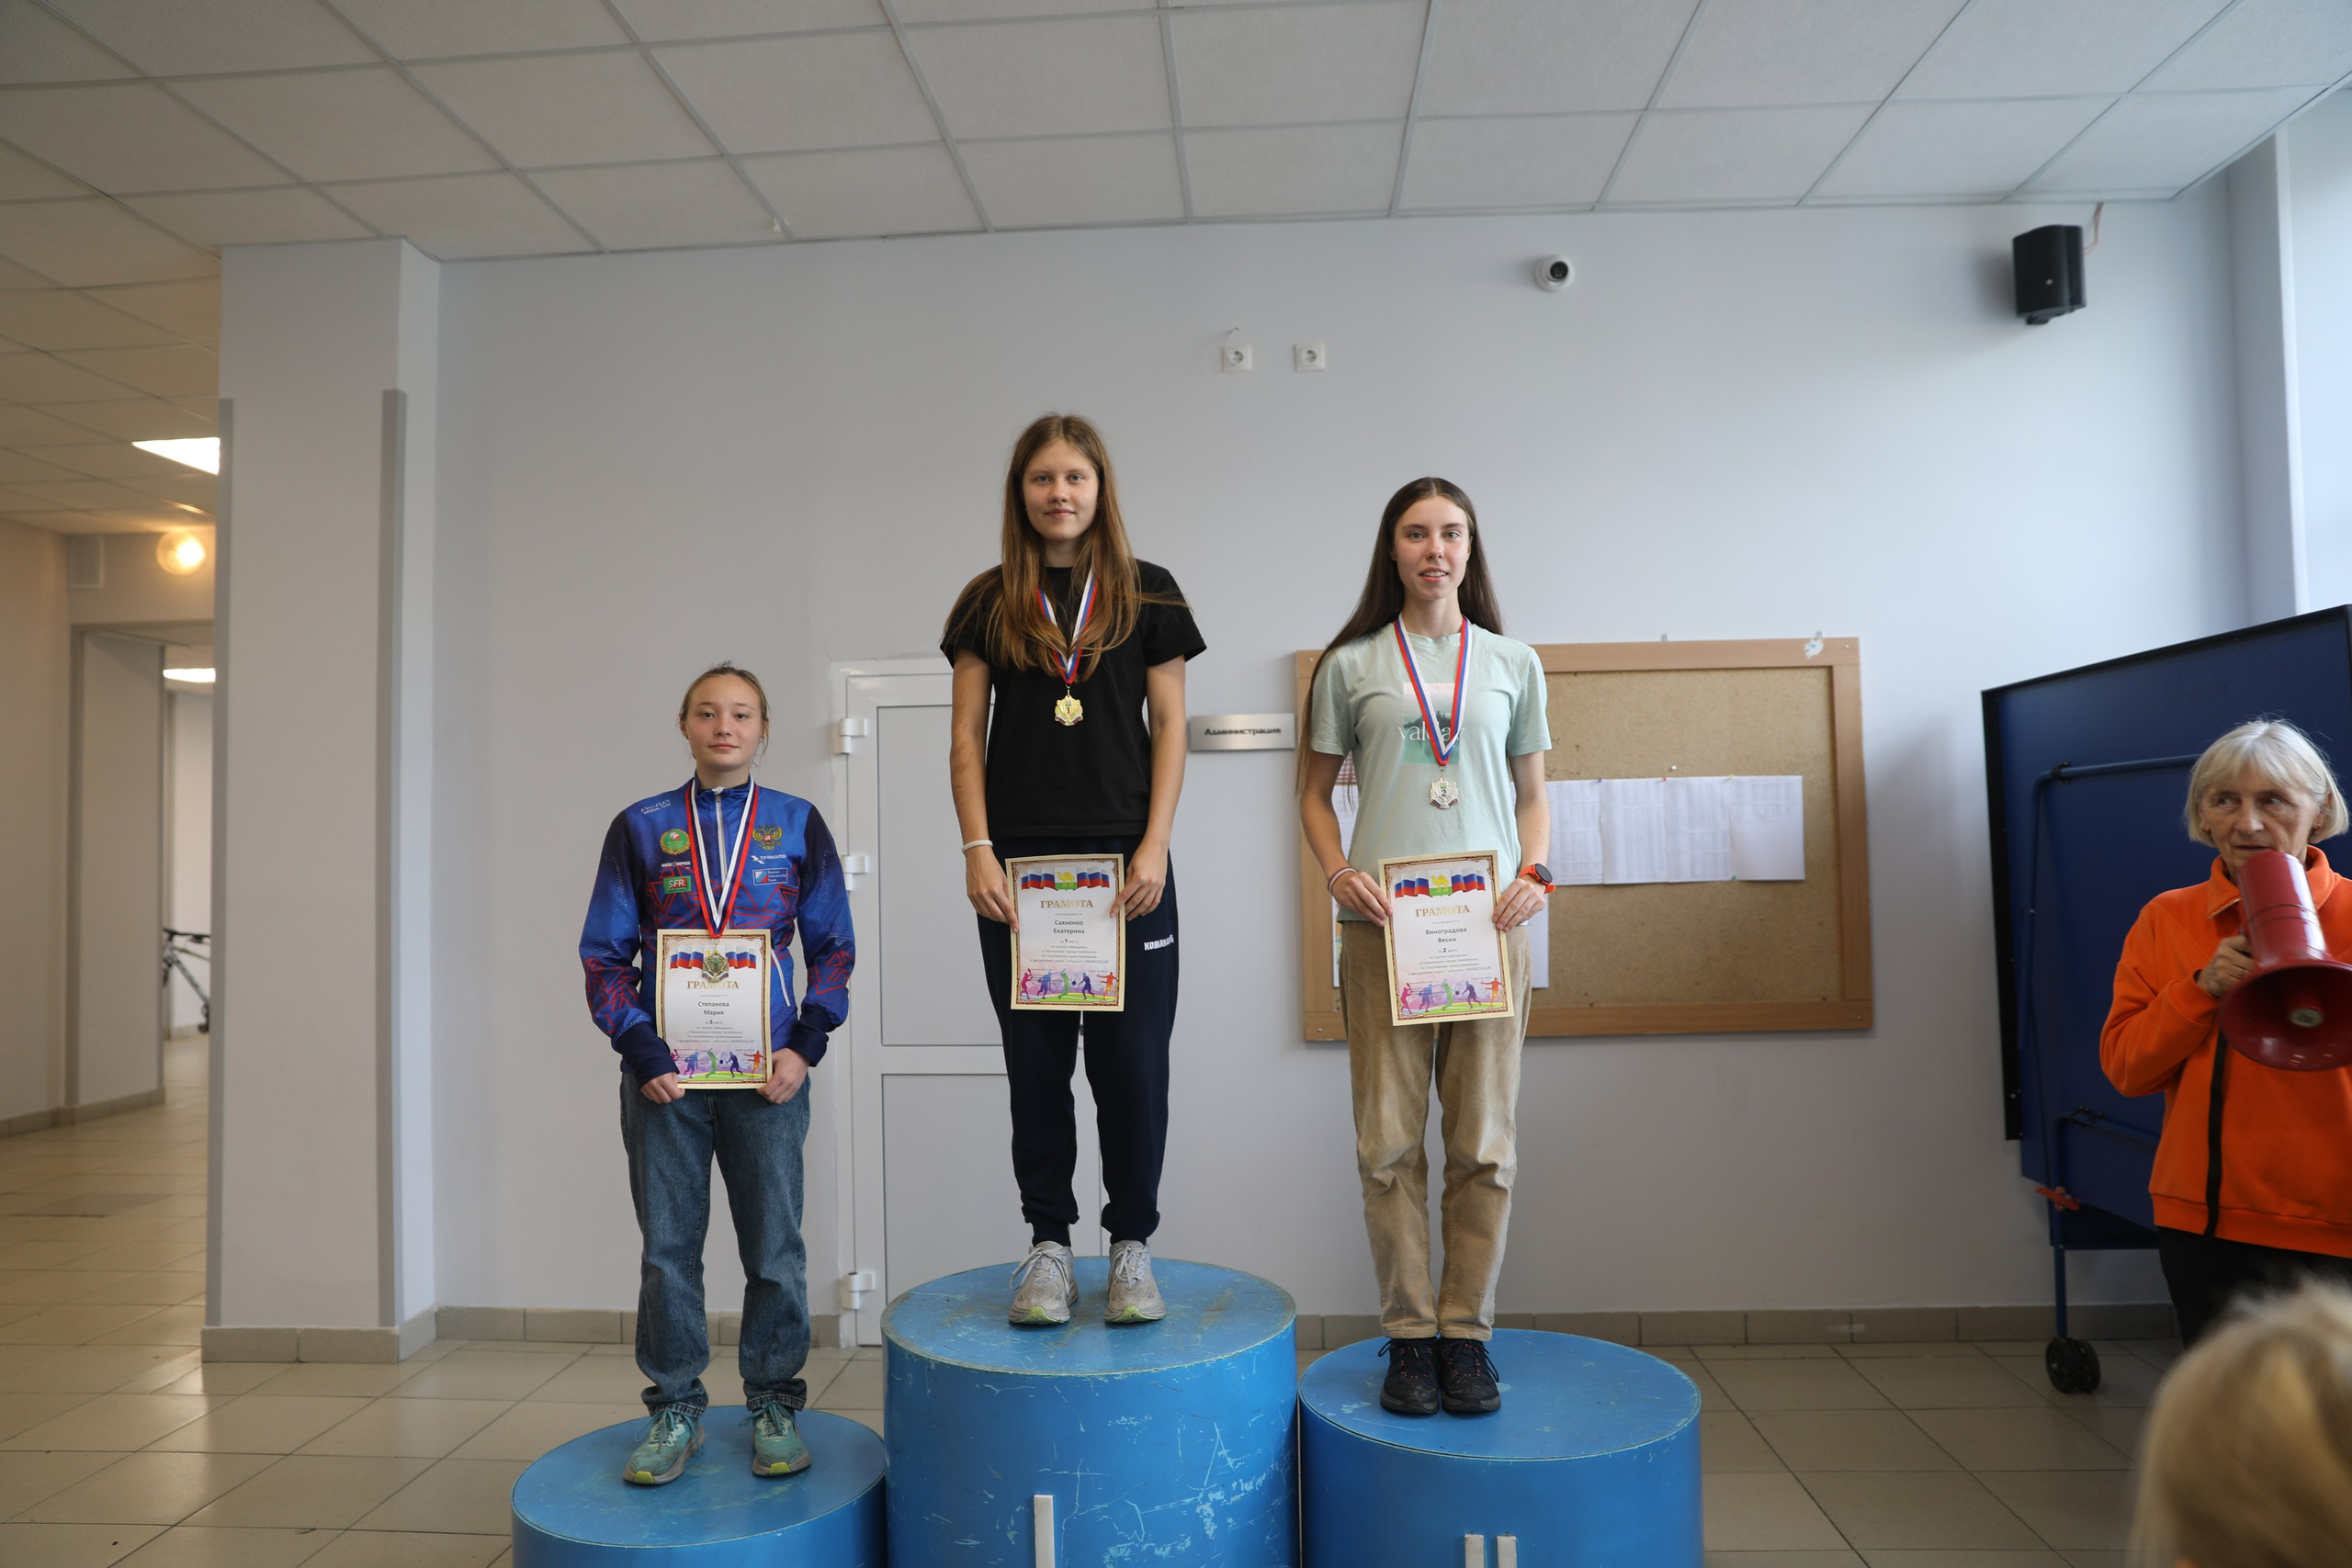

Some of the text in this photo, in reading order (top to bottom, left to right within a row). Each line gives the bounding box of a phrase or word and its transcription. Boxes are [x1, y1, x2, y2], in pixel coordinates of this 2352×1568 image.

[1204, 728, 1282, 736] Администрация
[1397, 721, 1464, 746] vala
[1441, 789, 1447, 797] 2
[668, 879, 685, 888] SFR
[1040, 899, 1094, 908] ГРАМОТА
[1415, 905, 1470, 918] ГРАМОТА
[686, 980, 740, 989] ГРАМОТА
